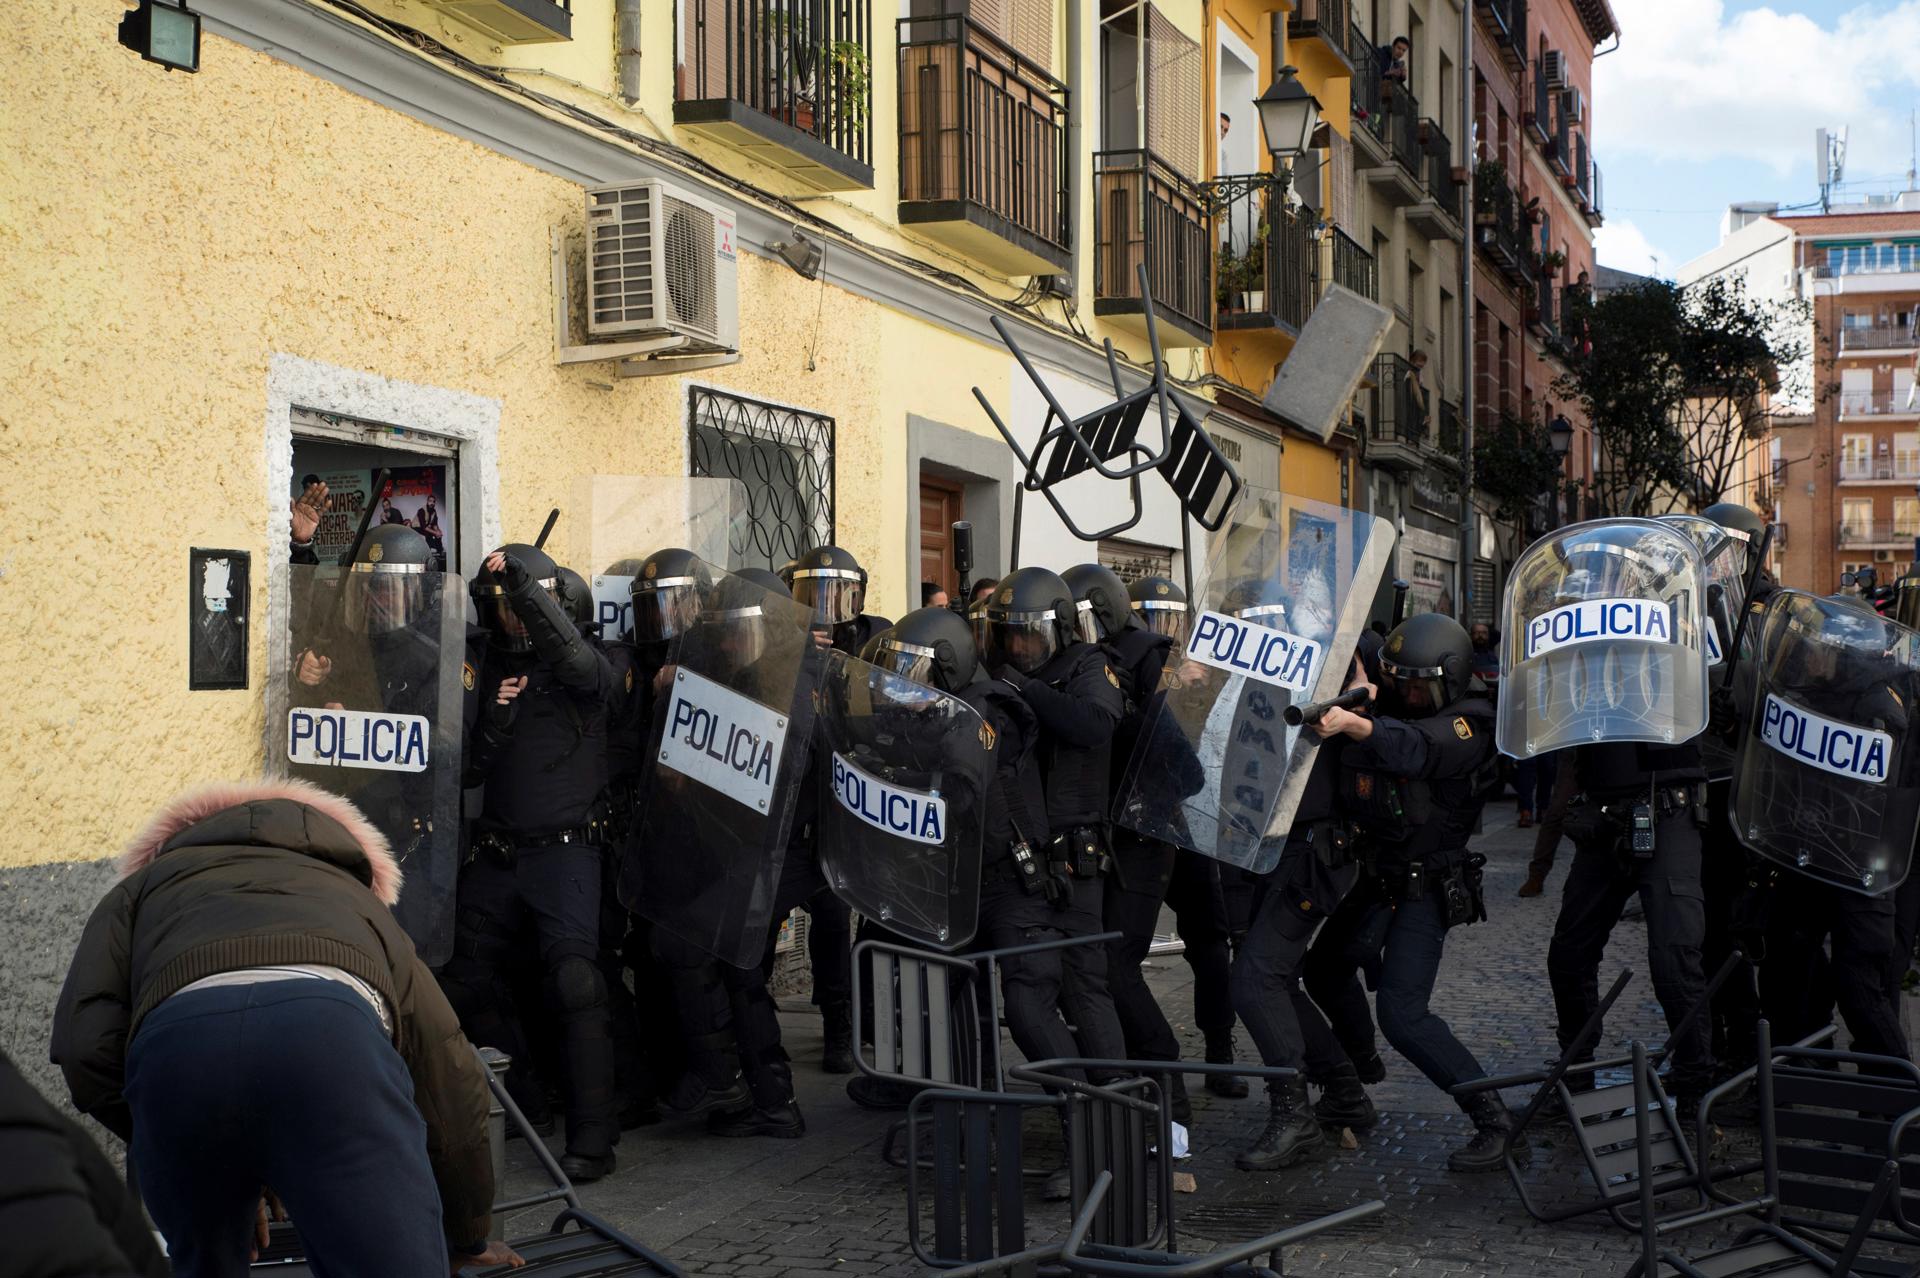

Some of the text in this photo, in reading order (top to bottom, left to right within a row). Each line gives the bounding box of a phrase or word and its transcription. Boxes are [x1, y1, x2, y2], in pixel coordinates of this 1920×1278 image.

[313, 514, 350, 533] ARCAR
[324, 493, 355, 513] AVAR
[1190, 615, 1314, 687] POLICIA
[1531, 603, 1667, 654] POLICIA
[291, 713, 425, 766] POLICIA
[670, 698, 774, 786] POLICIA
[1763, 698, 1884, 778] POLICIA
[834, 756, 941, 840] POLICIA
